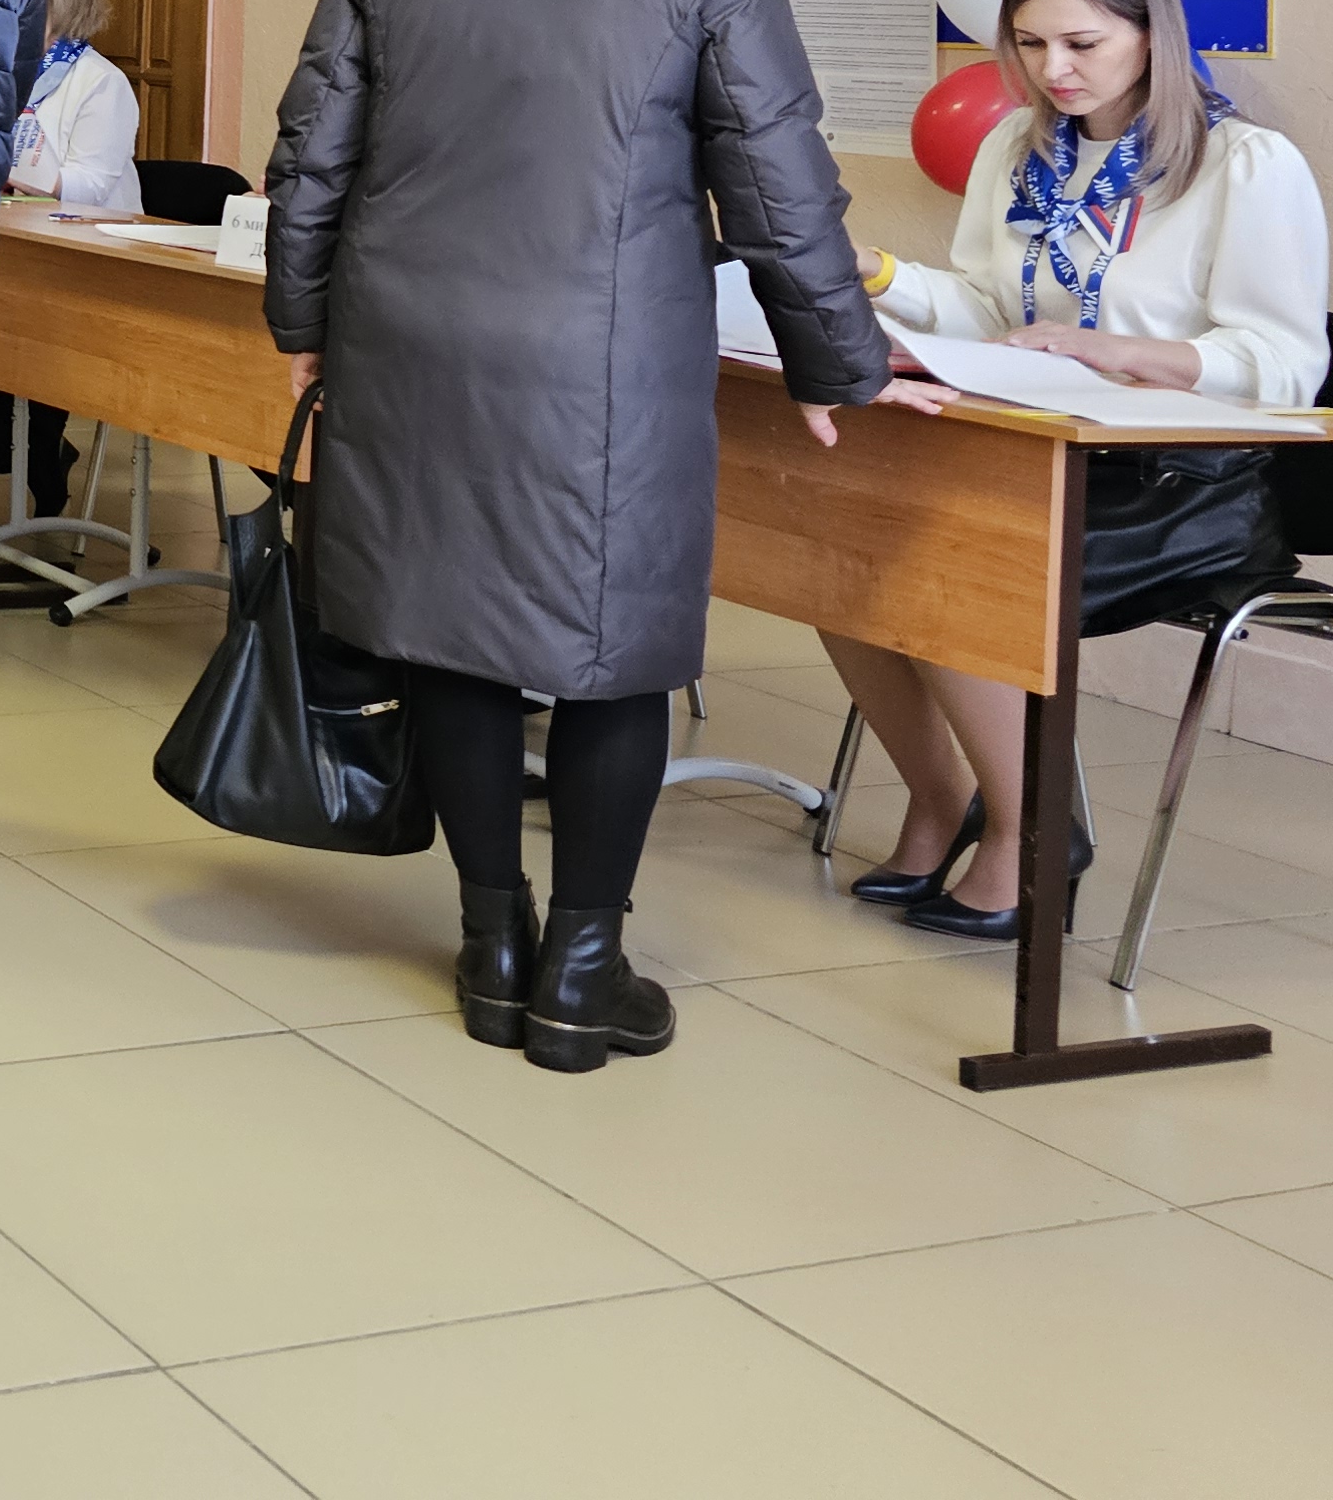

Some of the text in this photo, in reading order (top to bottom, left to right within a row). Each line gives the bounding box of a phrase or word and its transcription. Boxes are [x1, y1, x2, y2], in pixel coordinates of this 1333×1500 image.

[1117, 132, 1139, 168] УИК
[1093, 176, 1117, 209] УИК
[231, 214, 265, 232] 6 ми
[1023, 237, 1044, 268] УИК
[1089, 254, 1112, 276] ИК
[1022, 281, 1035, 312] УИК
[1081, 290, 1100, 322] УИК
